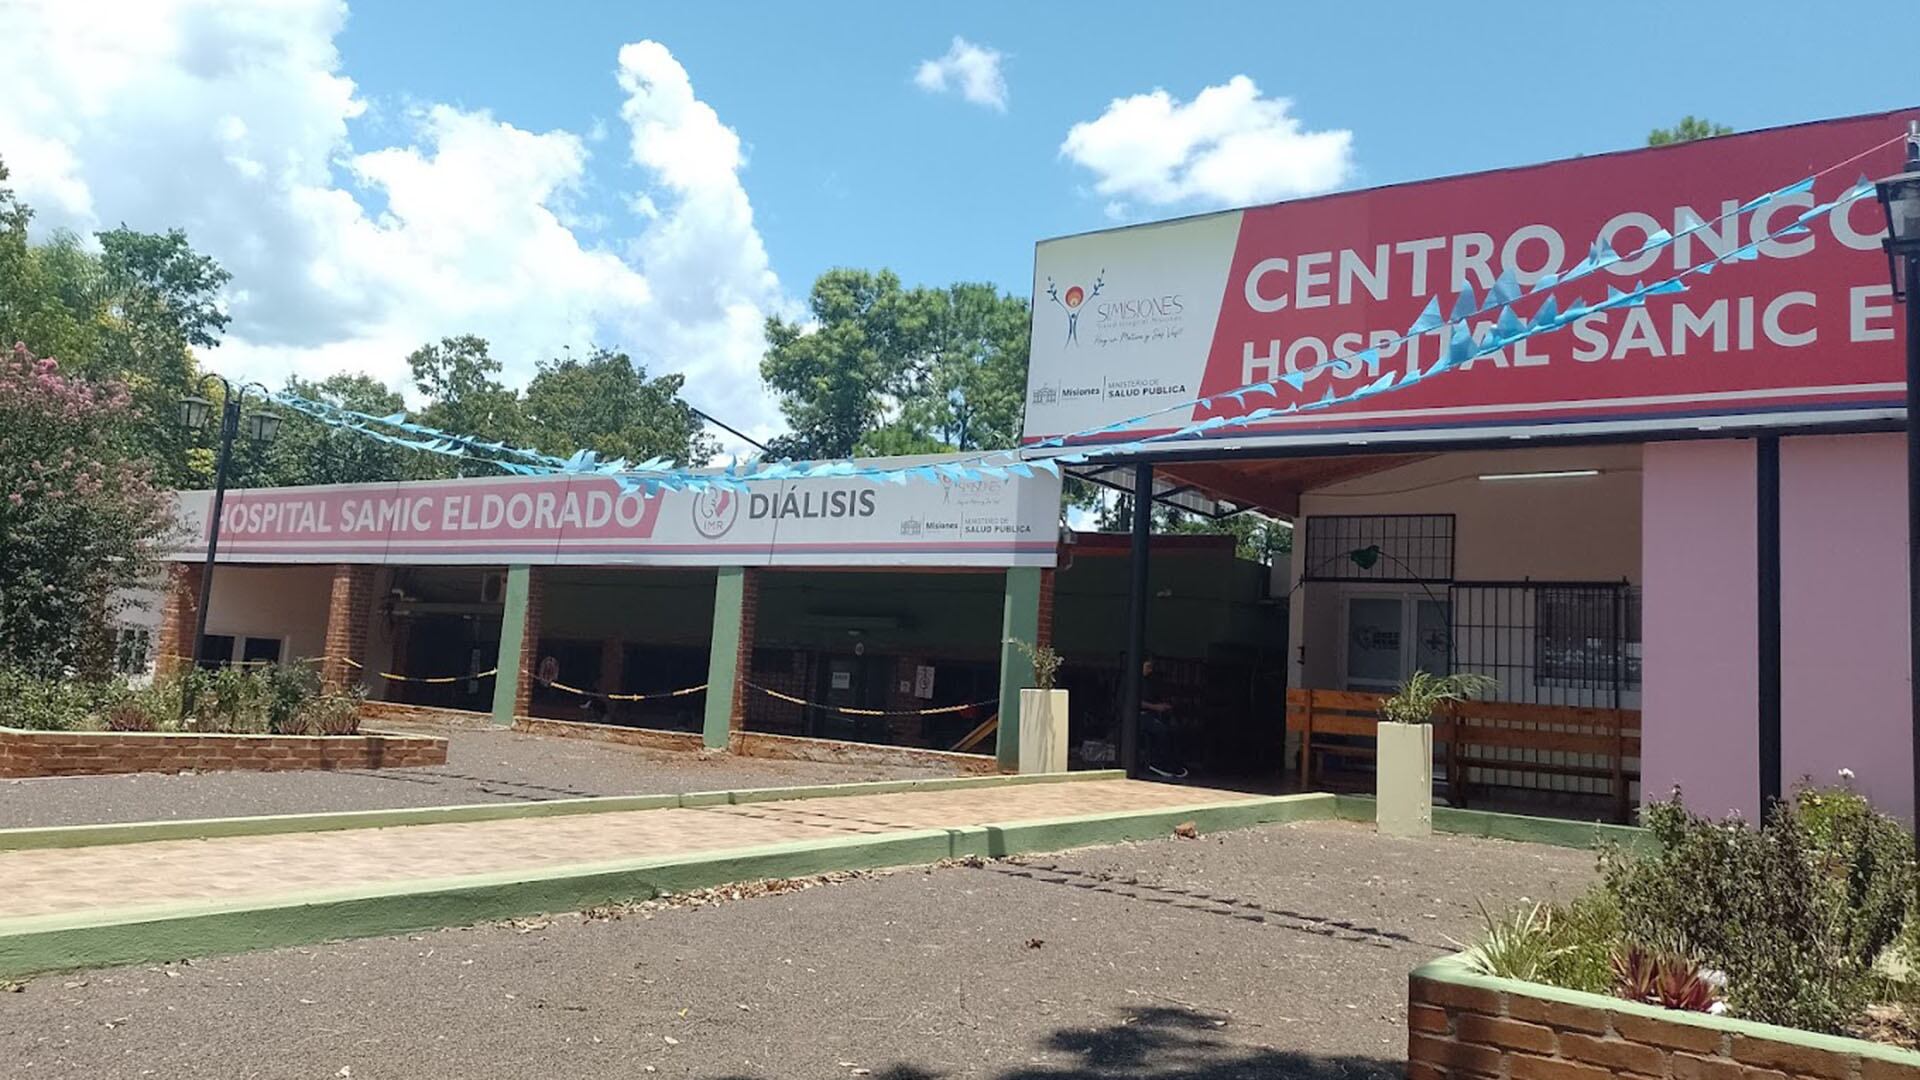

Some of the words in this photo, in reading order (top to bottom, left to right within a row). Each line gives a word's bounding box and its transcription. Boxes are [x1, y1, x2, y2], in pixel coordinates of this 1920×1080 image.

[1245, 224, 1565, 312] CENTRO
[1241, 316, 1550, 386] HOSPITAL
[1572, 290, 1818, 362] SAMIC
[1062, 388, 1100, 397] Misiones
[1108, 388, 1140, 398] SALUD
[749, 485, 876, 520] DIÁLISIS
[219, 502, 332, 534] HOSPITAL
[339, 498, 432, 532] SAMIC
[441, 490, 645, 531] ELDORADO
[703, 520, 724, 531] IMR
[926, 521, 958, 530] Misiones
[965, 525, 992, 533] SALUD
